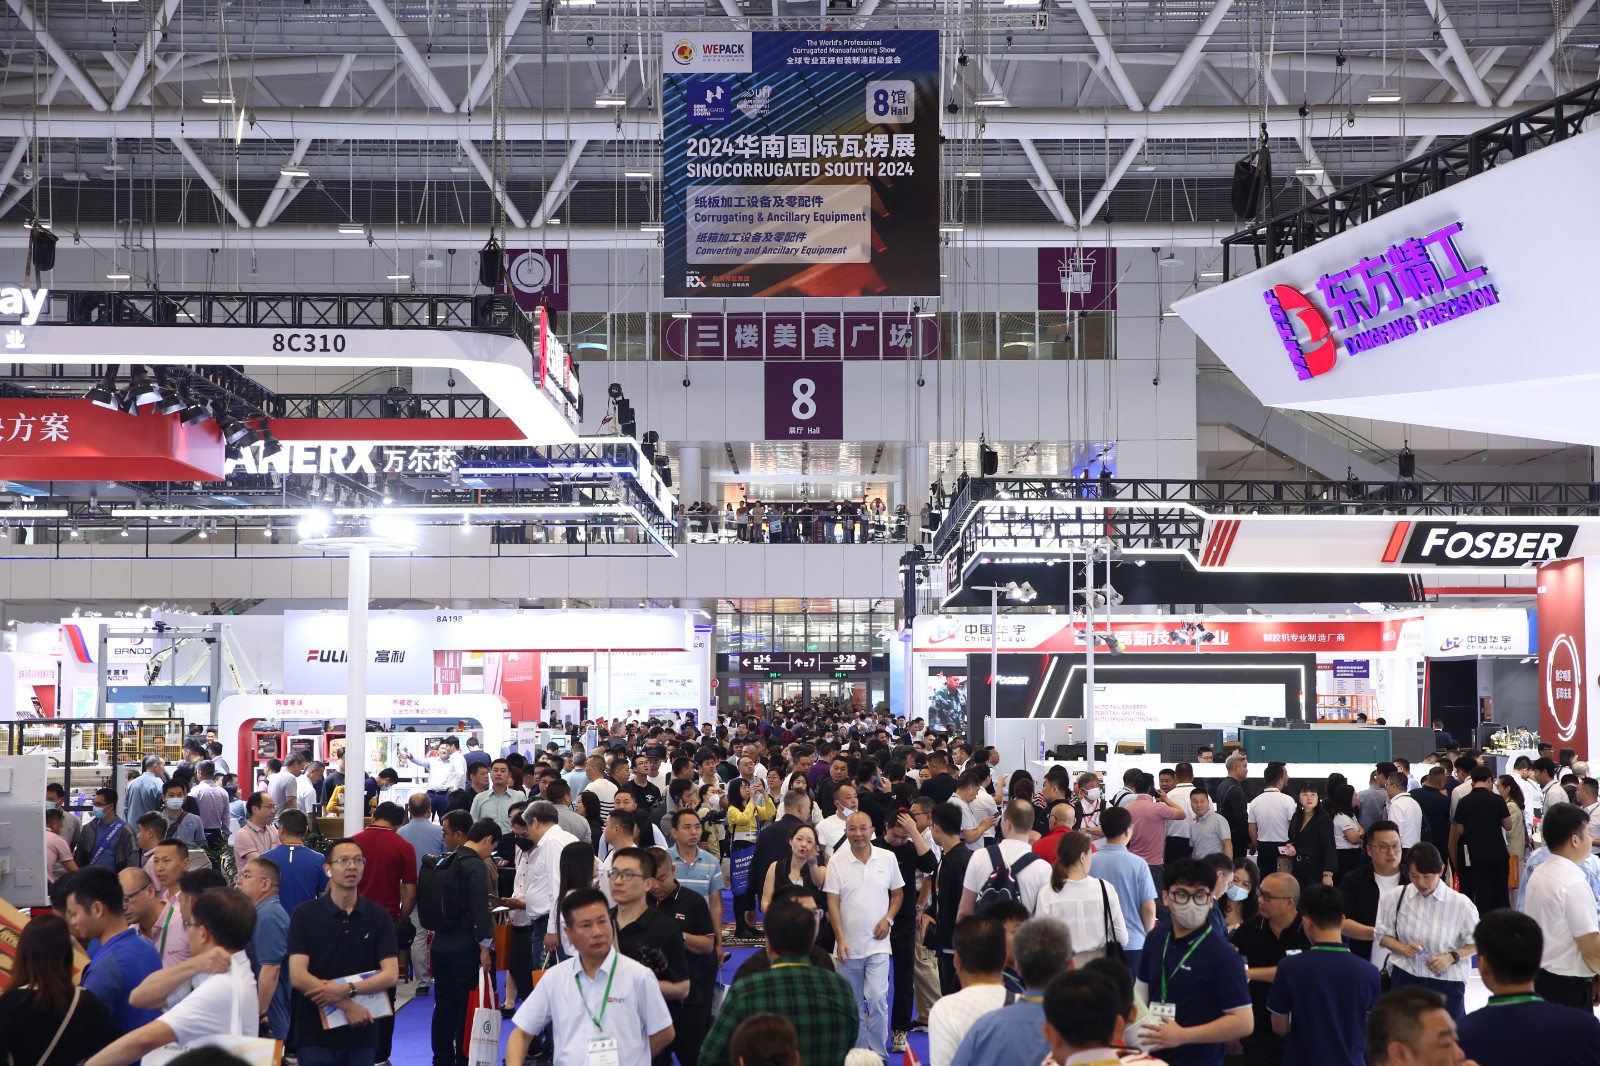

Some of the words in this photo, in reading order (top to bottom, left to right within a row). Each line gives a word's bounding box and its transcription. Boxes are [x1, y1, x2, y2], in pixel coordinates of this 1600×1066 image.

[702, 44, 744, 54] WEPACK
[874, 88, 889, 116] 8
[891, 90, 906, 104] 馆
[891, 106, 908, 116] Hall
[687, 134, 915, 158] 2024华南国际瓦楞展
[686, 162, 821, 178] SINOCORRUGATED
[824, 162, 874, 177] SOUTH
[878, 162, 914, 176] 2024
[694, 196, 824, 208] 纸板加工设备及零配件
[694, 212, 754, 224] Corrugating
[757, 212, 764, 222] &
[767, 212, 810, 224] Ancillary
[814, 211, 866, 223] Equipment
[696, 232, 806, 243] 纸箱加工设备及零配件
[695, 246, 742, 256] Converting
[743, 246, 760, 255] and
[761, 246, 799, 256] Ancillary
[801, 246, 847, 256] Equipment
[686, 276, 707, 287] RX
[1316, 221, 1488, 330] 东方精工
[1344, 315, 1418, 356] DONGFANG
[1417, 284, 1501, 330] PRECISION
[272, 333, 346, 352] 8C310
[696, 323, 913, 349] 三楼美食广场
[792, 378, 817, 420] 8
[383, 449, 456, 473] 万尔芯
[1421, 528, 1563, 559] FOSBER
[965, 624, 1025, 635] 中国华宇
[1263, 633, 1345, 643] 制胶机专业制造厂商
[374, 650, 405, 662] 富利
[809, 658, 815, 667] 7
